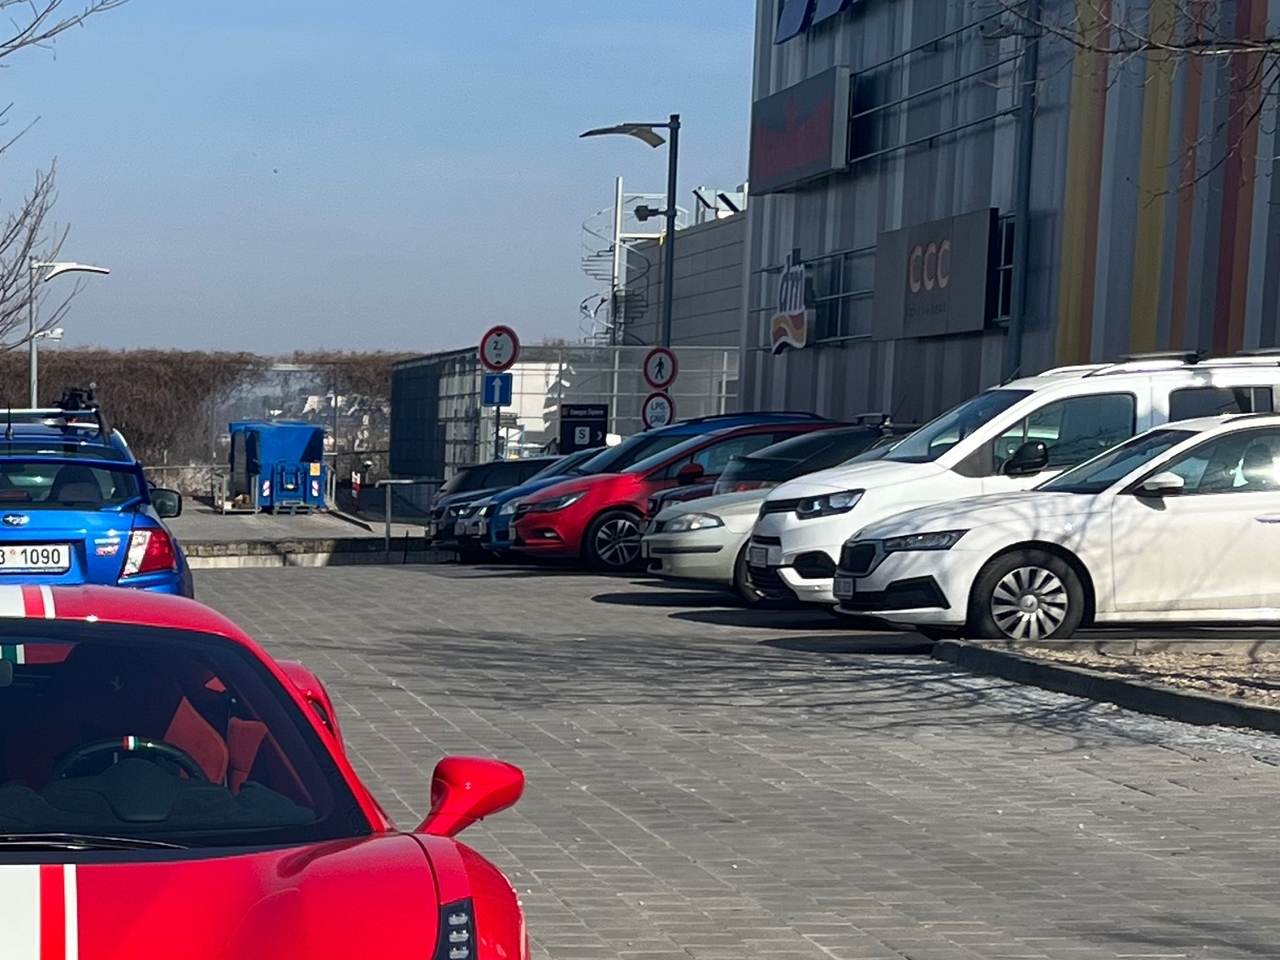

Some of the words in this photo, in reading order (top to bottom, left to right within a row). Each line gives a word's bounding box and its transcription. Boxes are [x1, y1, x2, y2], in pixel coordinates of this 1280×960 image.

[909, 239, 951, 293] CCC
[578, 428, 586, 440] S
[21, 548, 61, 565] 1090
